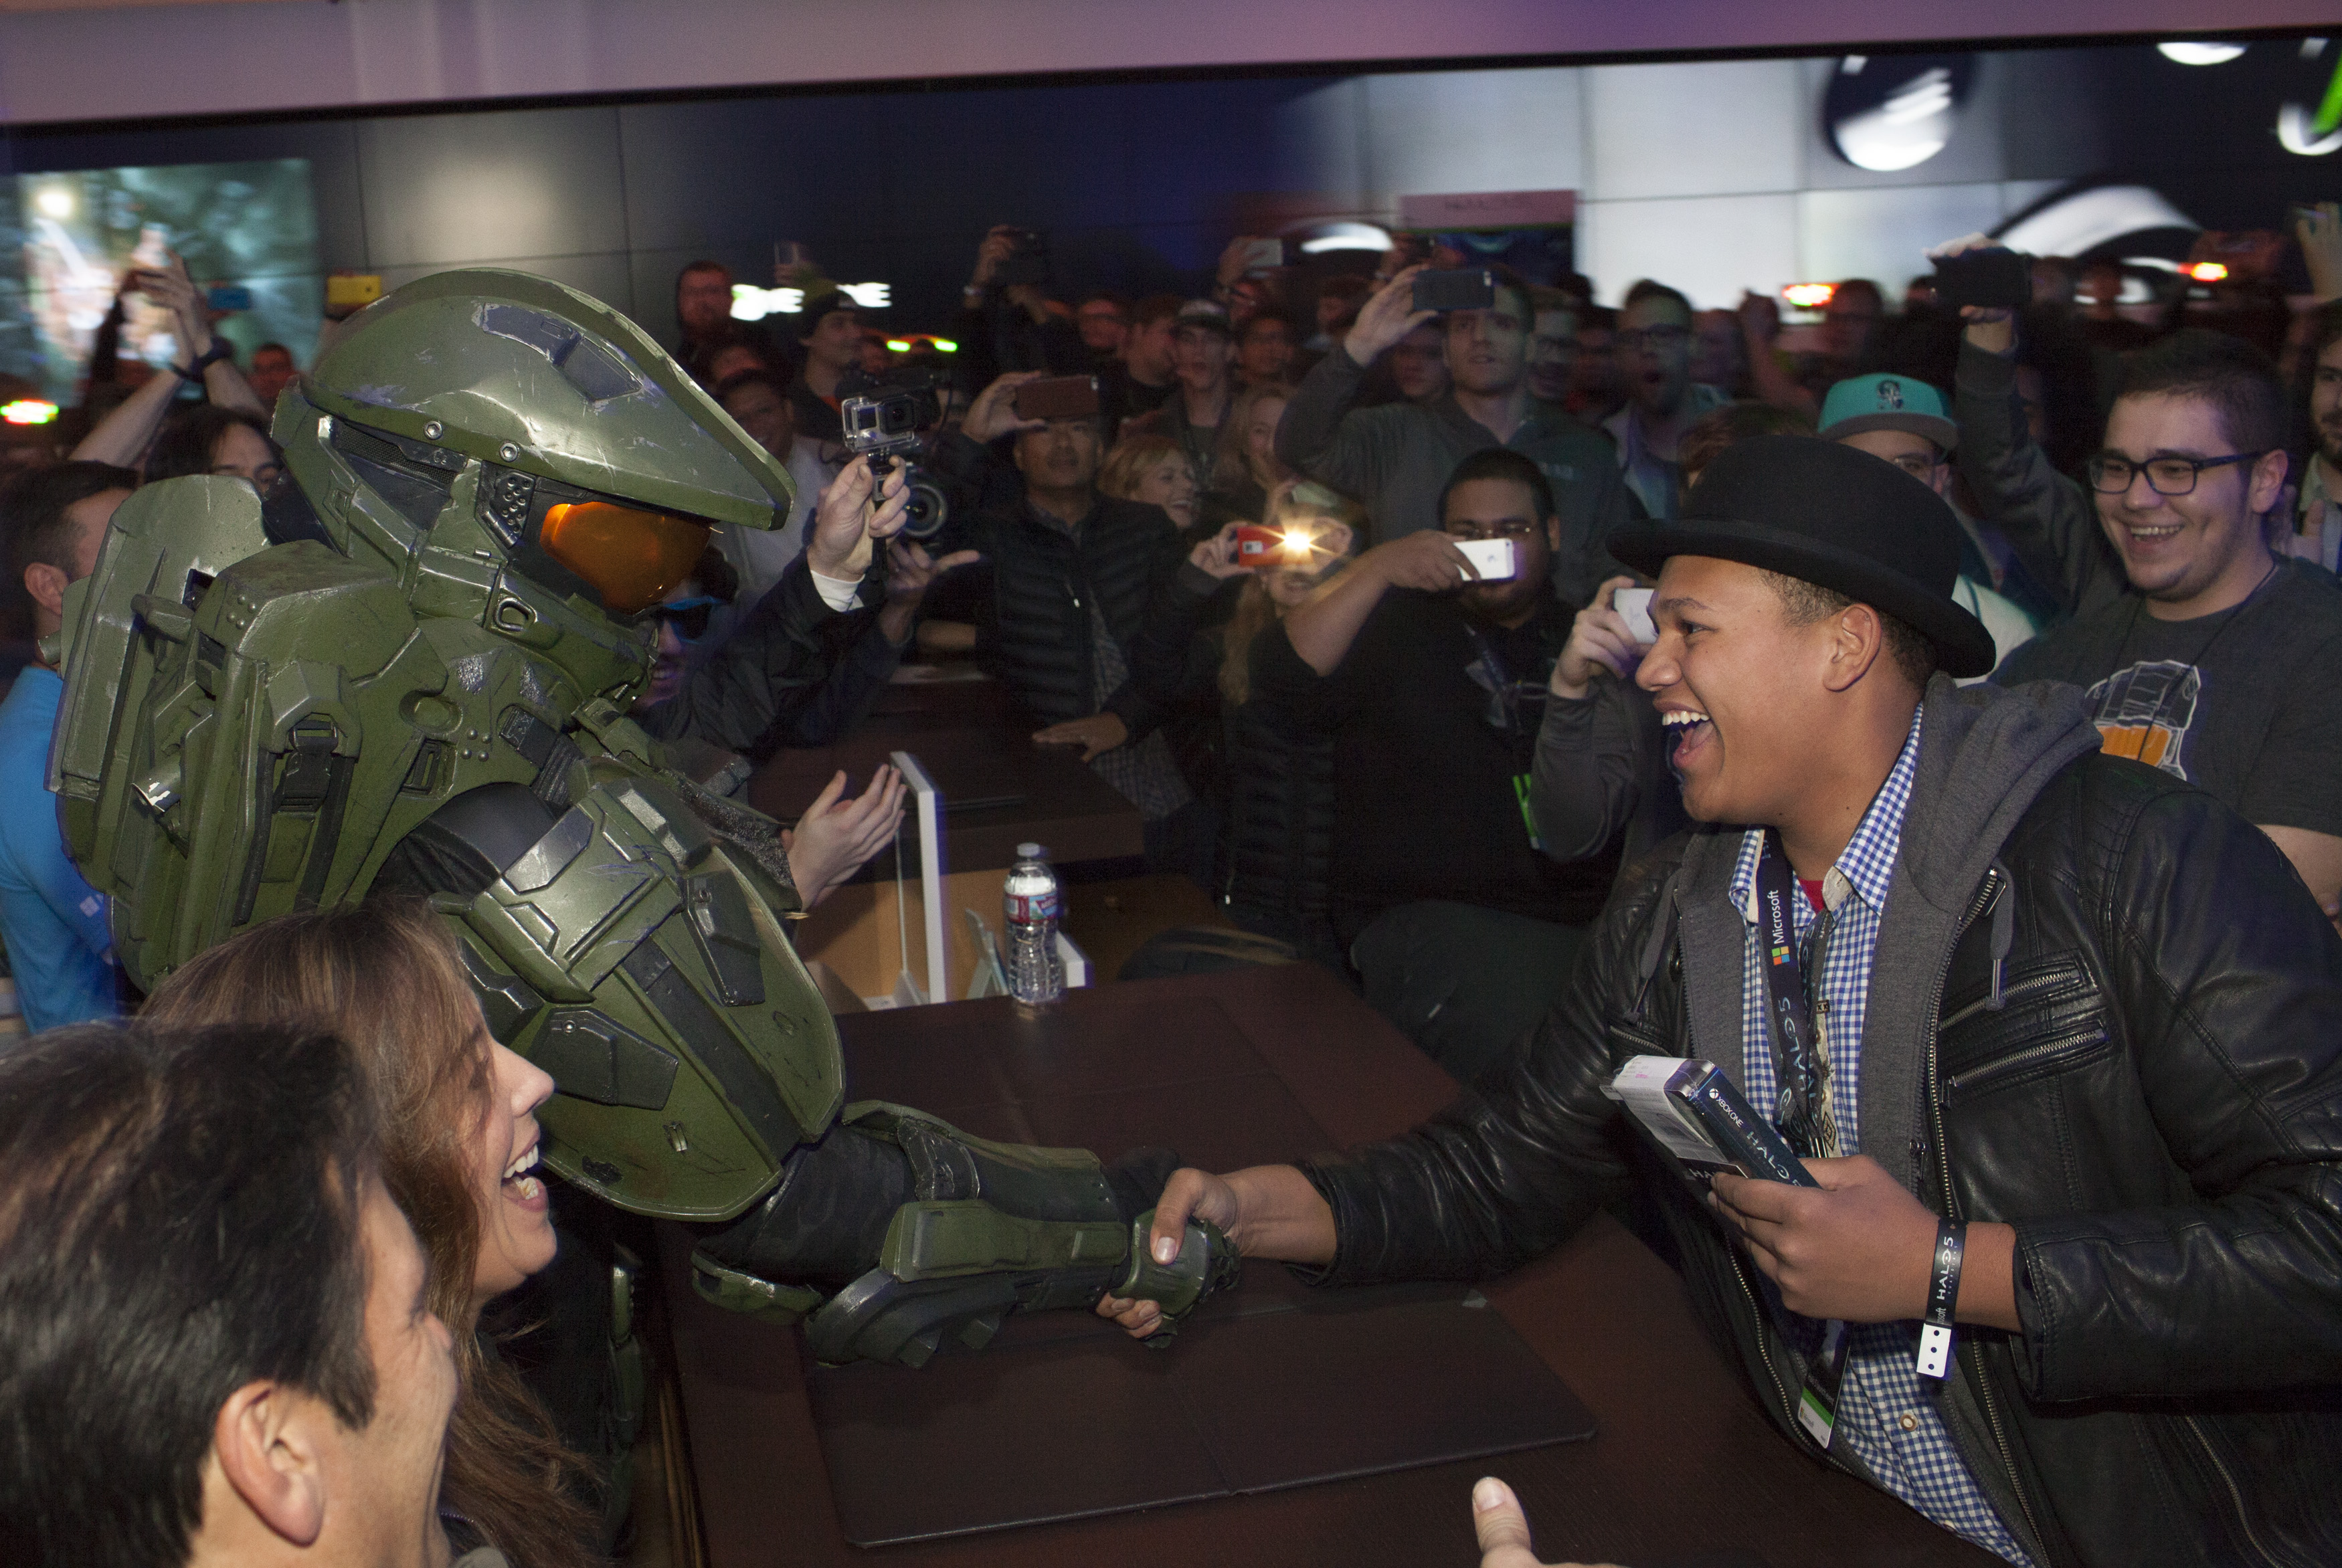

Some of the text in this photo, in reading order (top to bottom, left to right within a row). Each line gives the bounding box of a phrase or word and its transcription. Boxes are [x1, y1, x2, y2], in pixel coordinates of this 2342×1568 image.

[1767, 890, 1785, 945] Microsoft
[1778, 996, 1791, 1012] 5
[1784, 1017, 1807, 1092] HALO
[1716, 1096, 1744, 1129] XBOX ONE
[1688, 1168, 1715, 1178] HA
[1746, 1131, 1789, 1179] HALO
[1936, 1236, 1954, 1300] HALO 5
